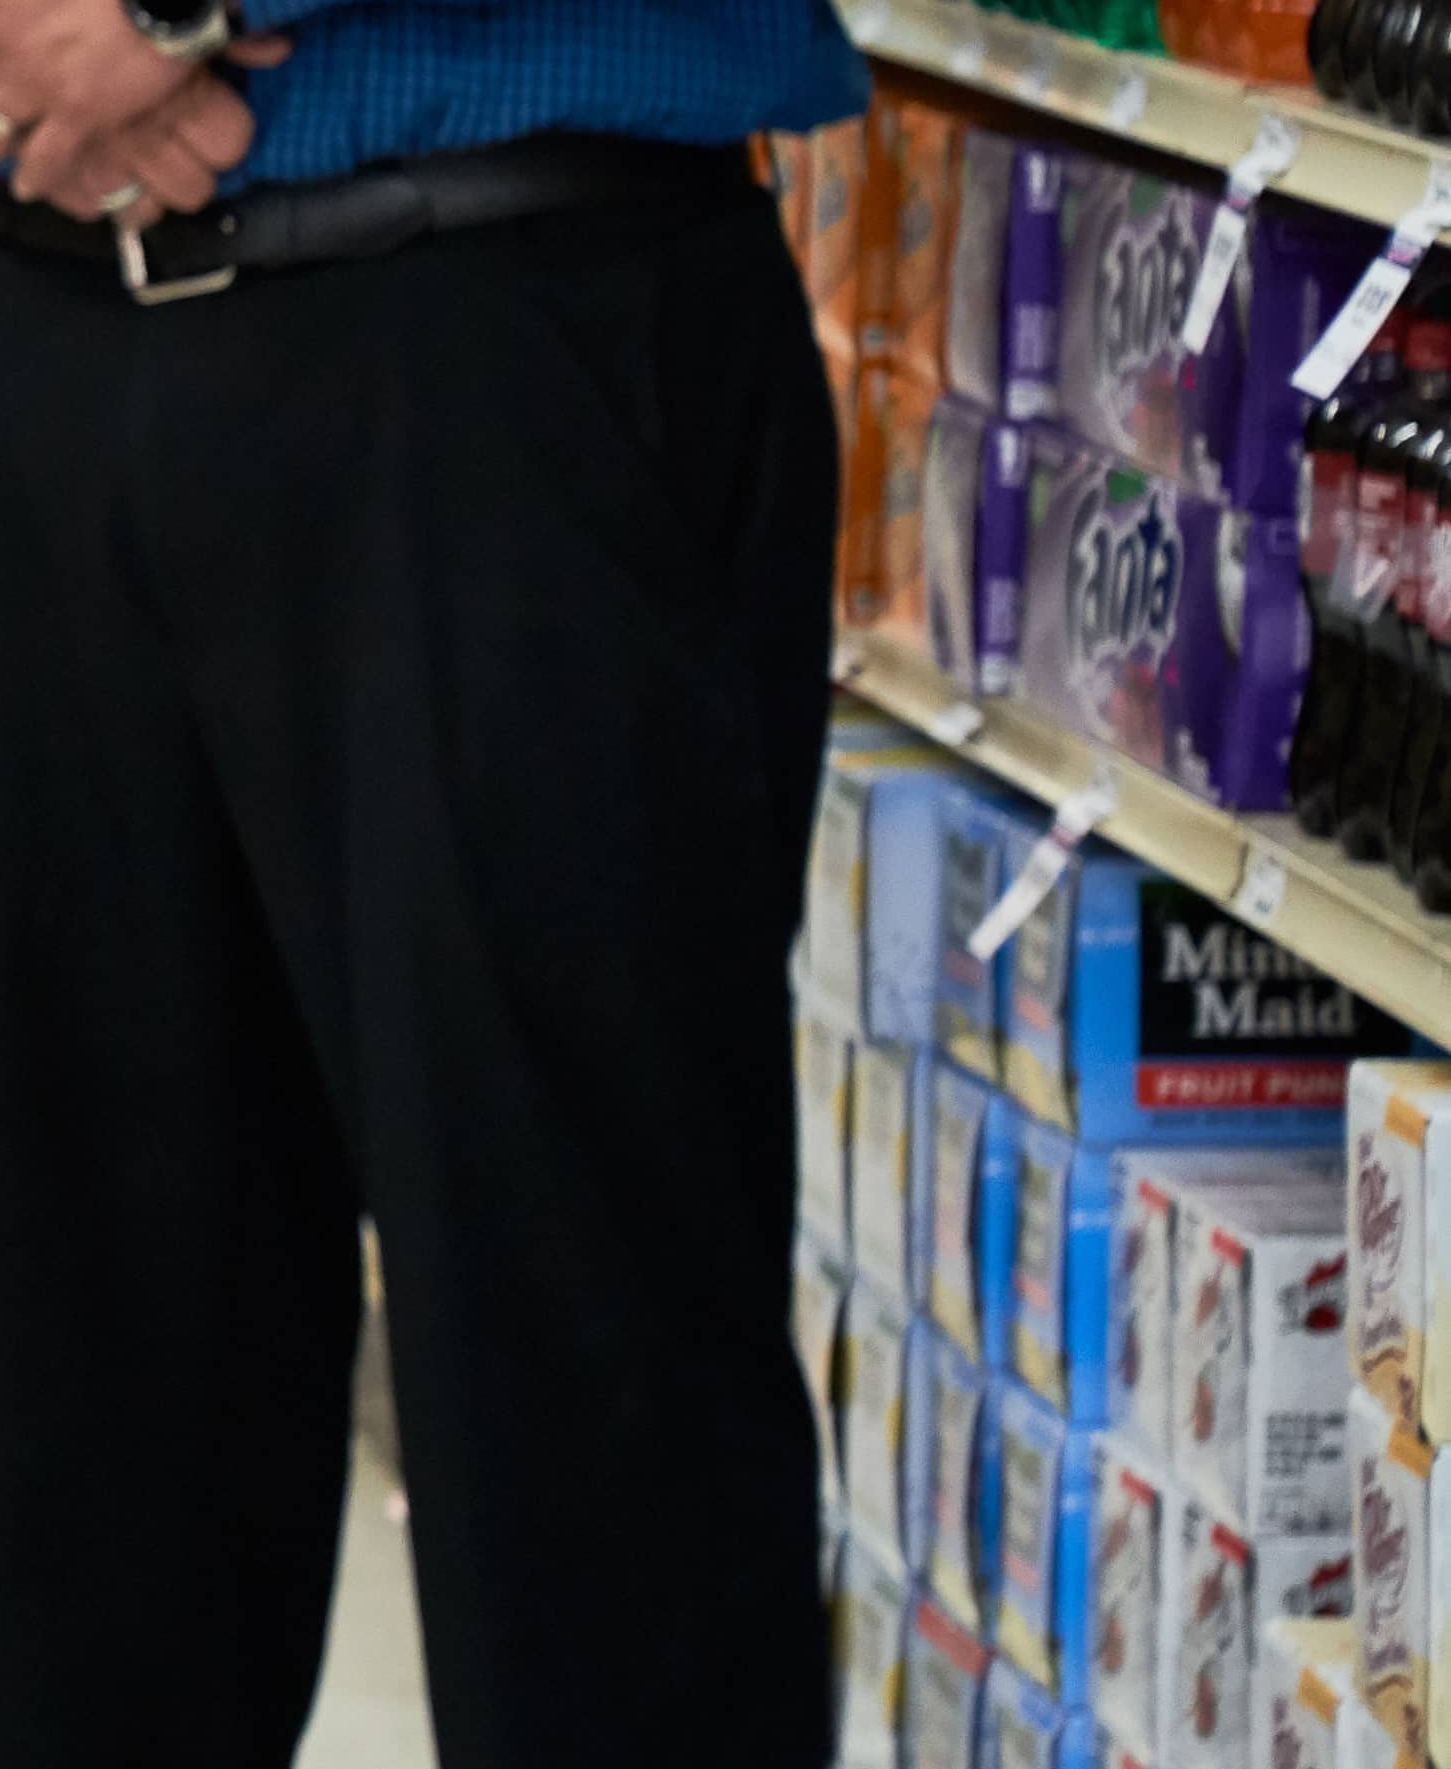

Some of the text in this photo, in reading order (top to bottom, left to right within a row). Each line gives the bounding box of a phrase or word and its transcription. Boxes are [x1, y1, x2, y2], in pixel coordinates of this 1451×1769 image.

[1193, 983, 1357, 1038] Maid
[1157, 1070, 1343, 1104] FRUIT PUN
